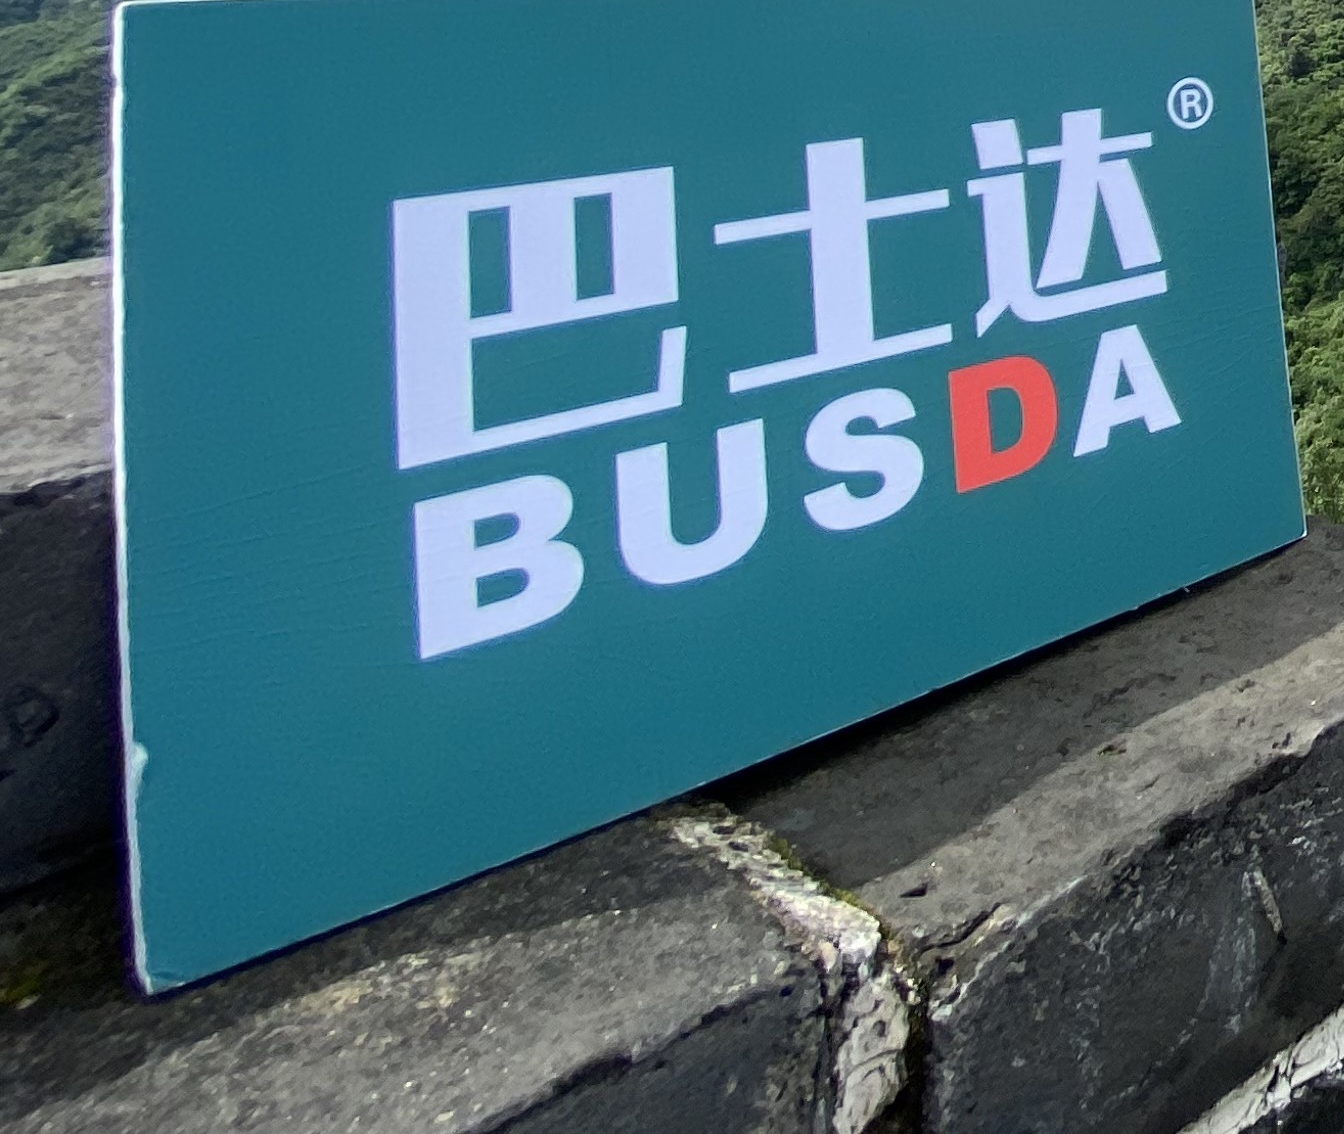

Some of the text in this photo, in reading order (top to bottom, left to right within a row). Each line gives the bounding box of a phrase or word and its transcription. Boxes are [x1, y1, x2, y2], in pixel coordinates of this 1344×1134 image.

[393, 109, 1169, 469] 巴士达
[415, 325, 1181, 659] BUSDA
